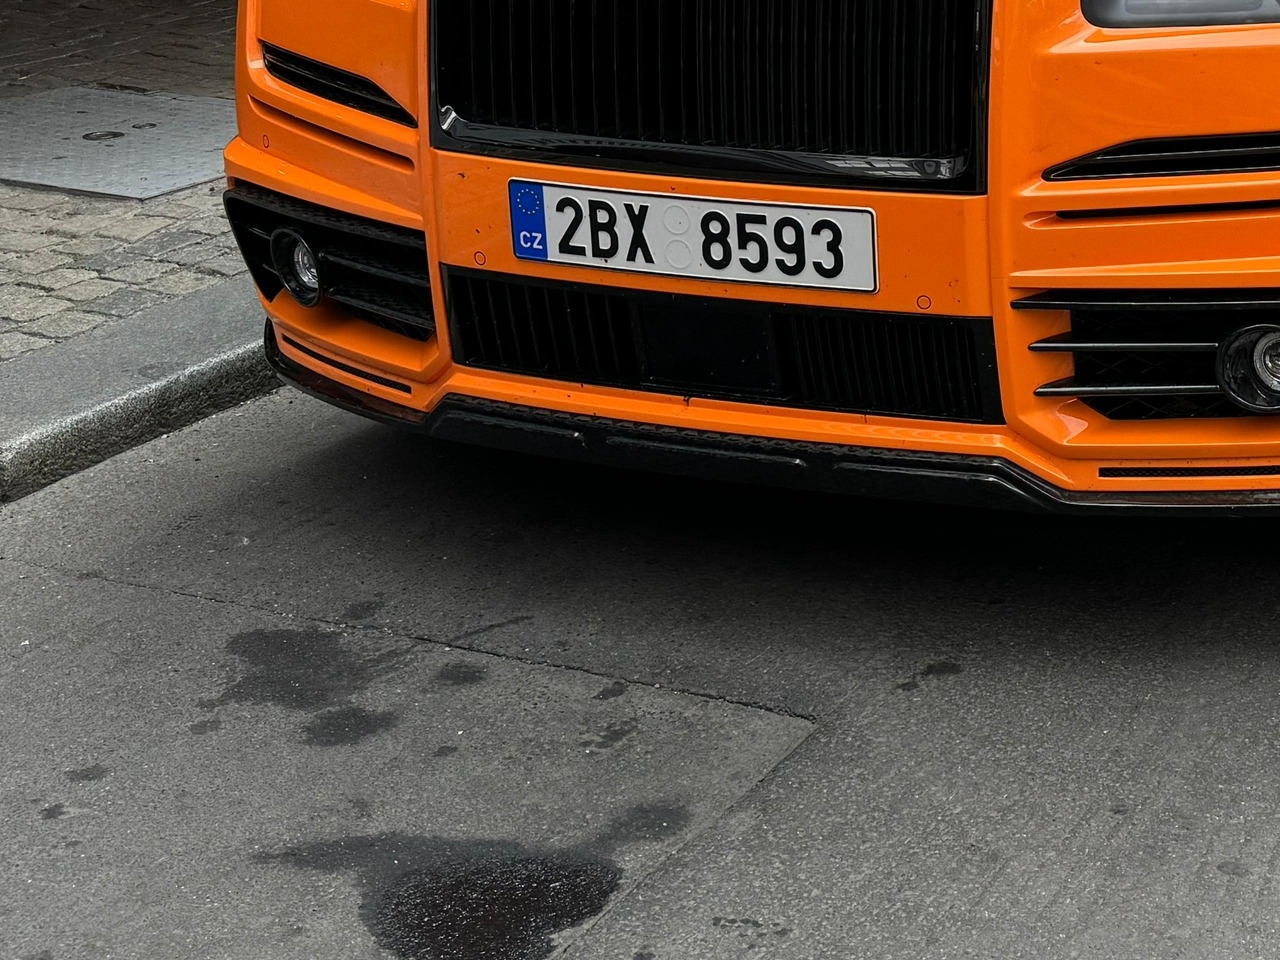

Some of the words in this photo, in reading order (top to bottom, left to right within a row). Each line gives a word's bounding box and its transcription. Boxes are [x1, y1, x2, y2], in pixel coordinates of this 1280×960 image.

[519, 230, 544, 250] CZ
[555, 196, 656, 264] 2BX
[700, 210, 845, 279] 8593
